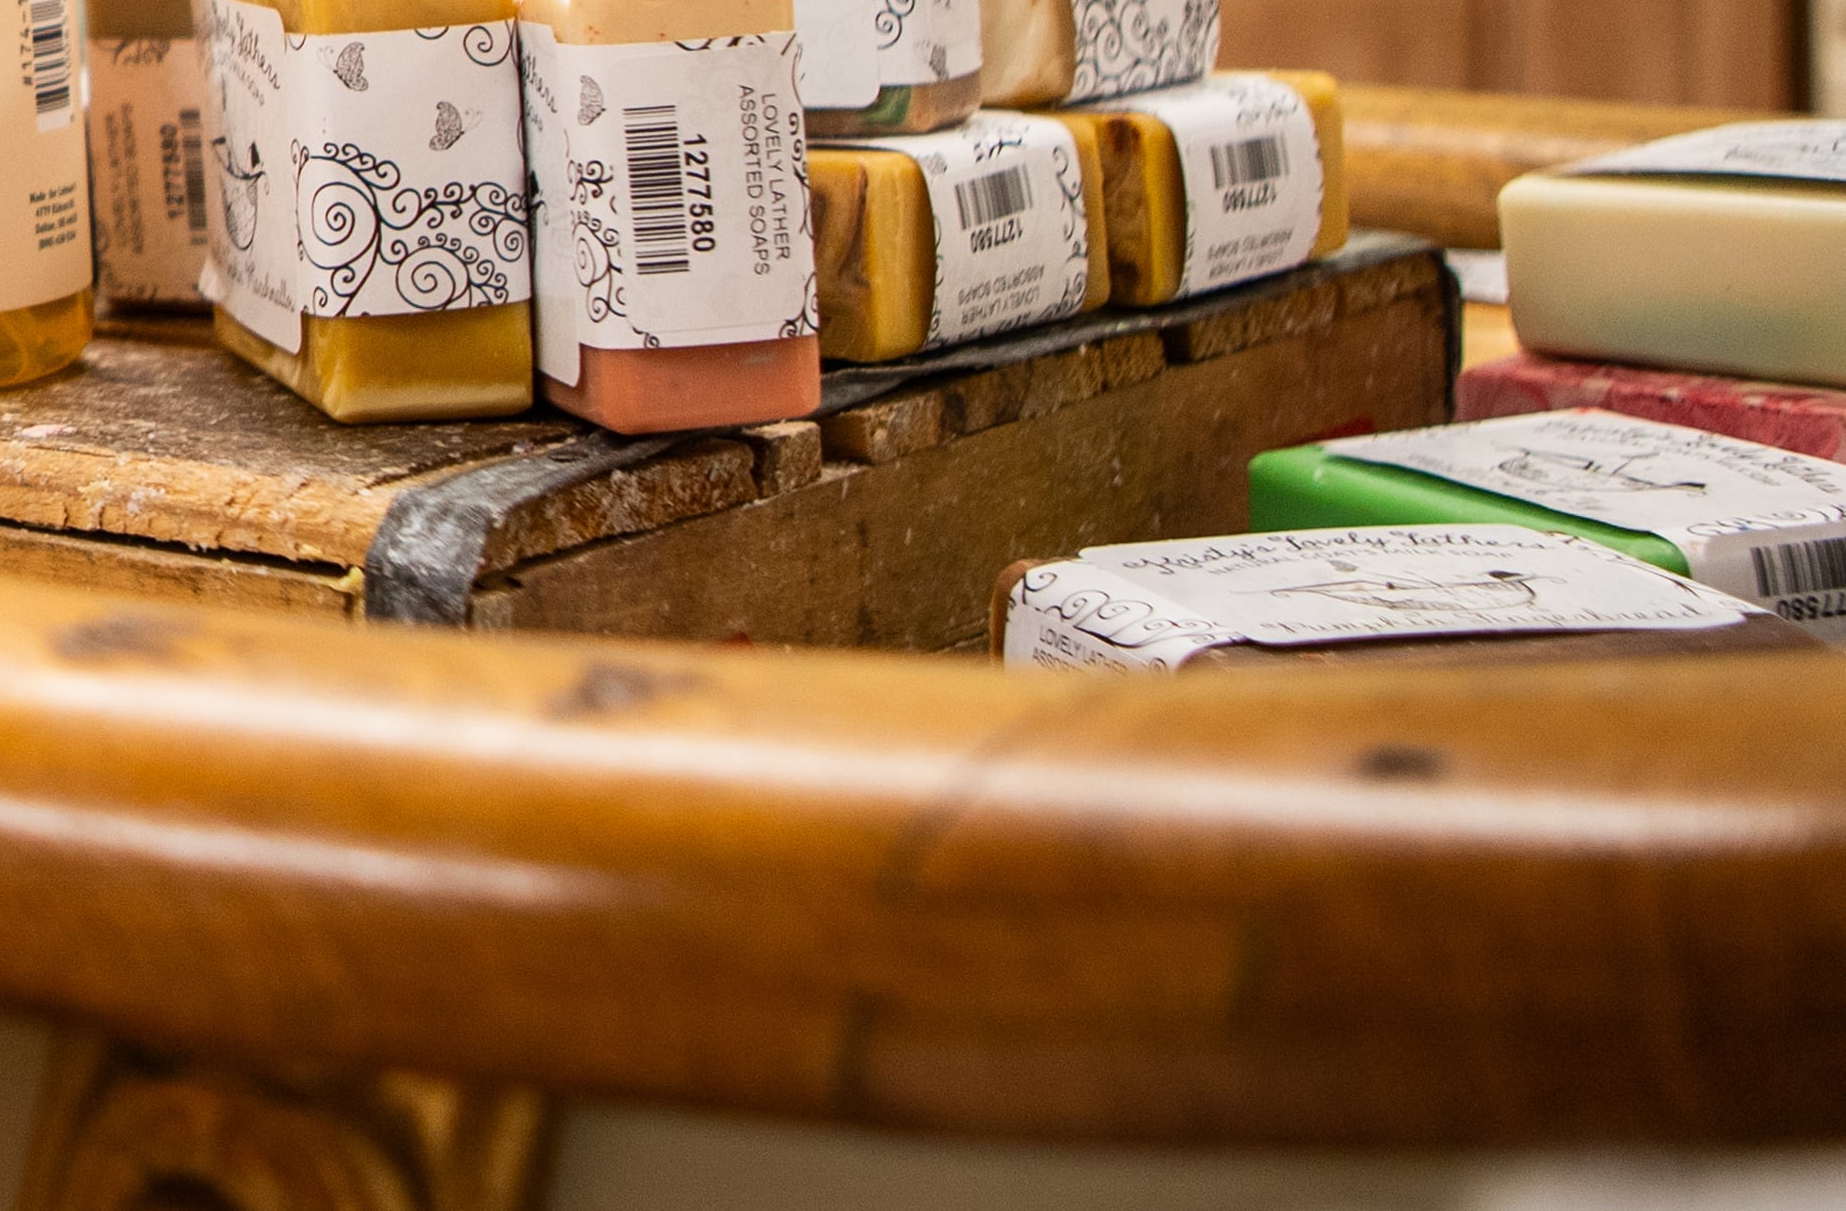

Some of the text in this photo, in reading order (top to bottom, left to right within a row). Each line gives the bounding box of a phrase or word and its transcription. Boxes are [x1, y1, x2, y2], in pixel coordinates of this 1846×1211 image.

[522, 51, 558, 114] thers
[682, 132, 717, 254] 1277580
[738, 83, 771, 276] ASSORTED SOAPS
[760, 93, 792, 262] LOVELY LATHER
